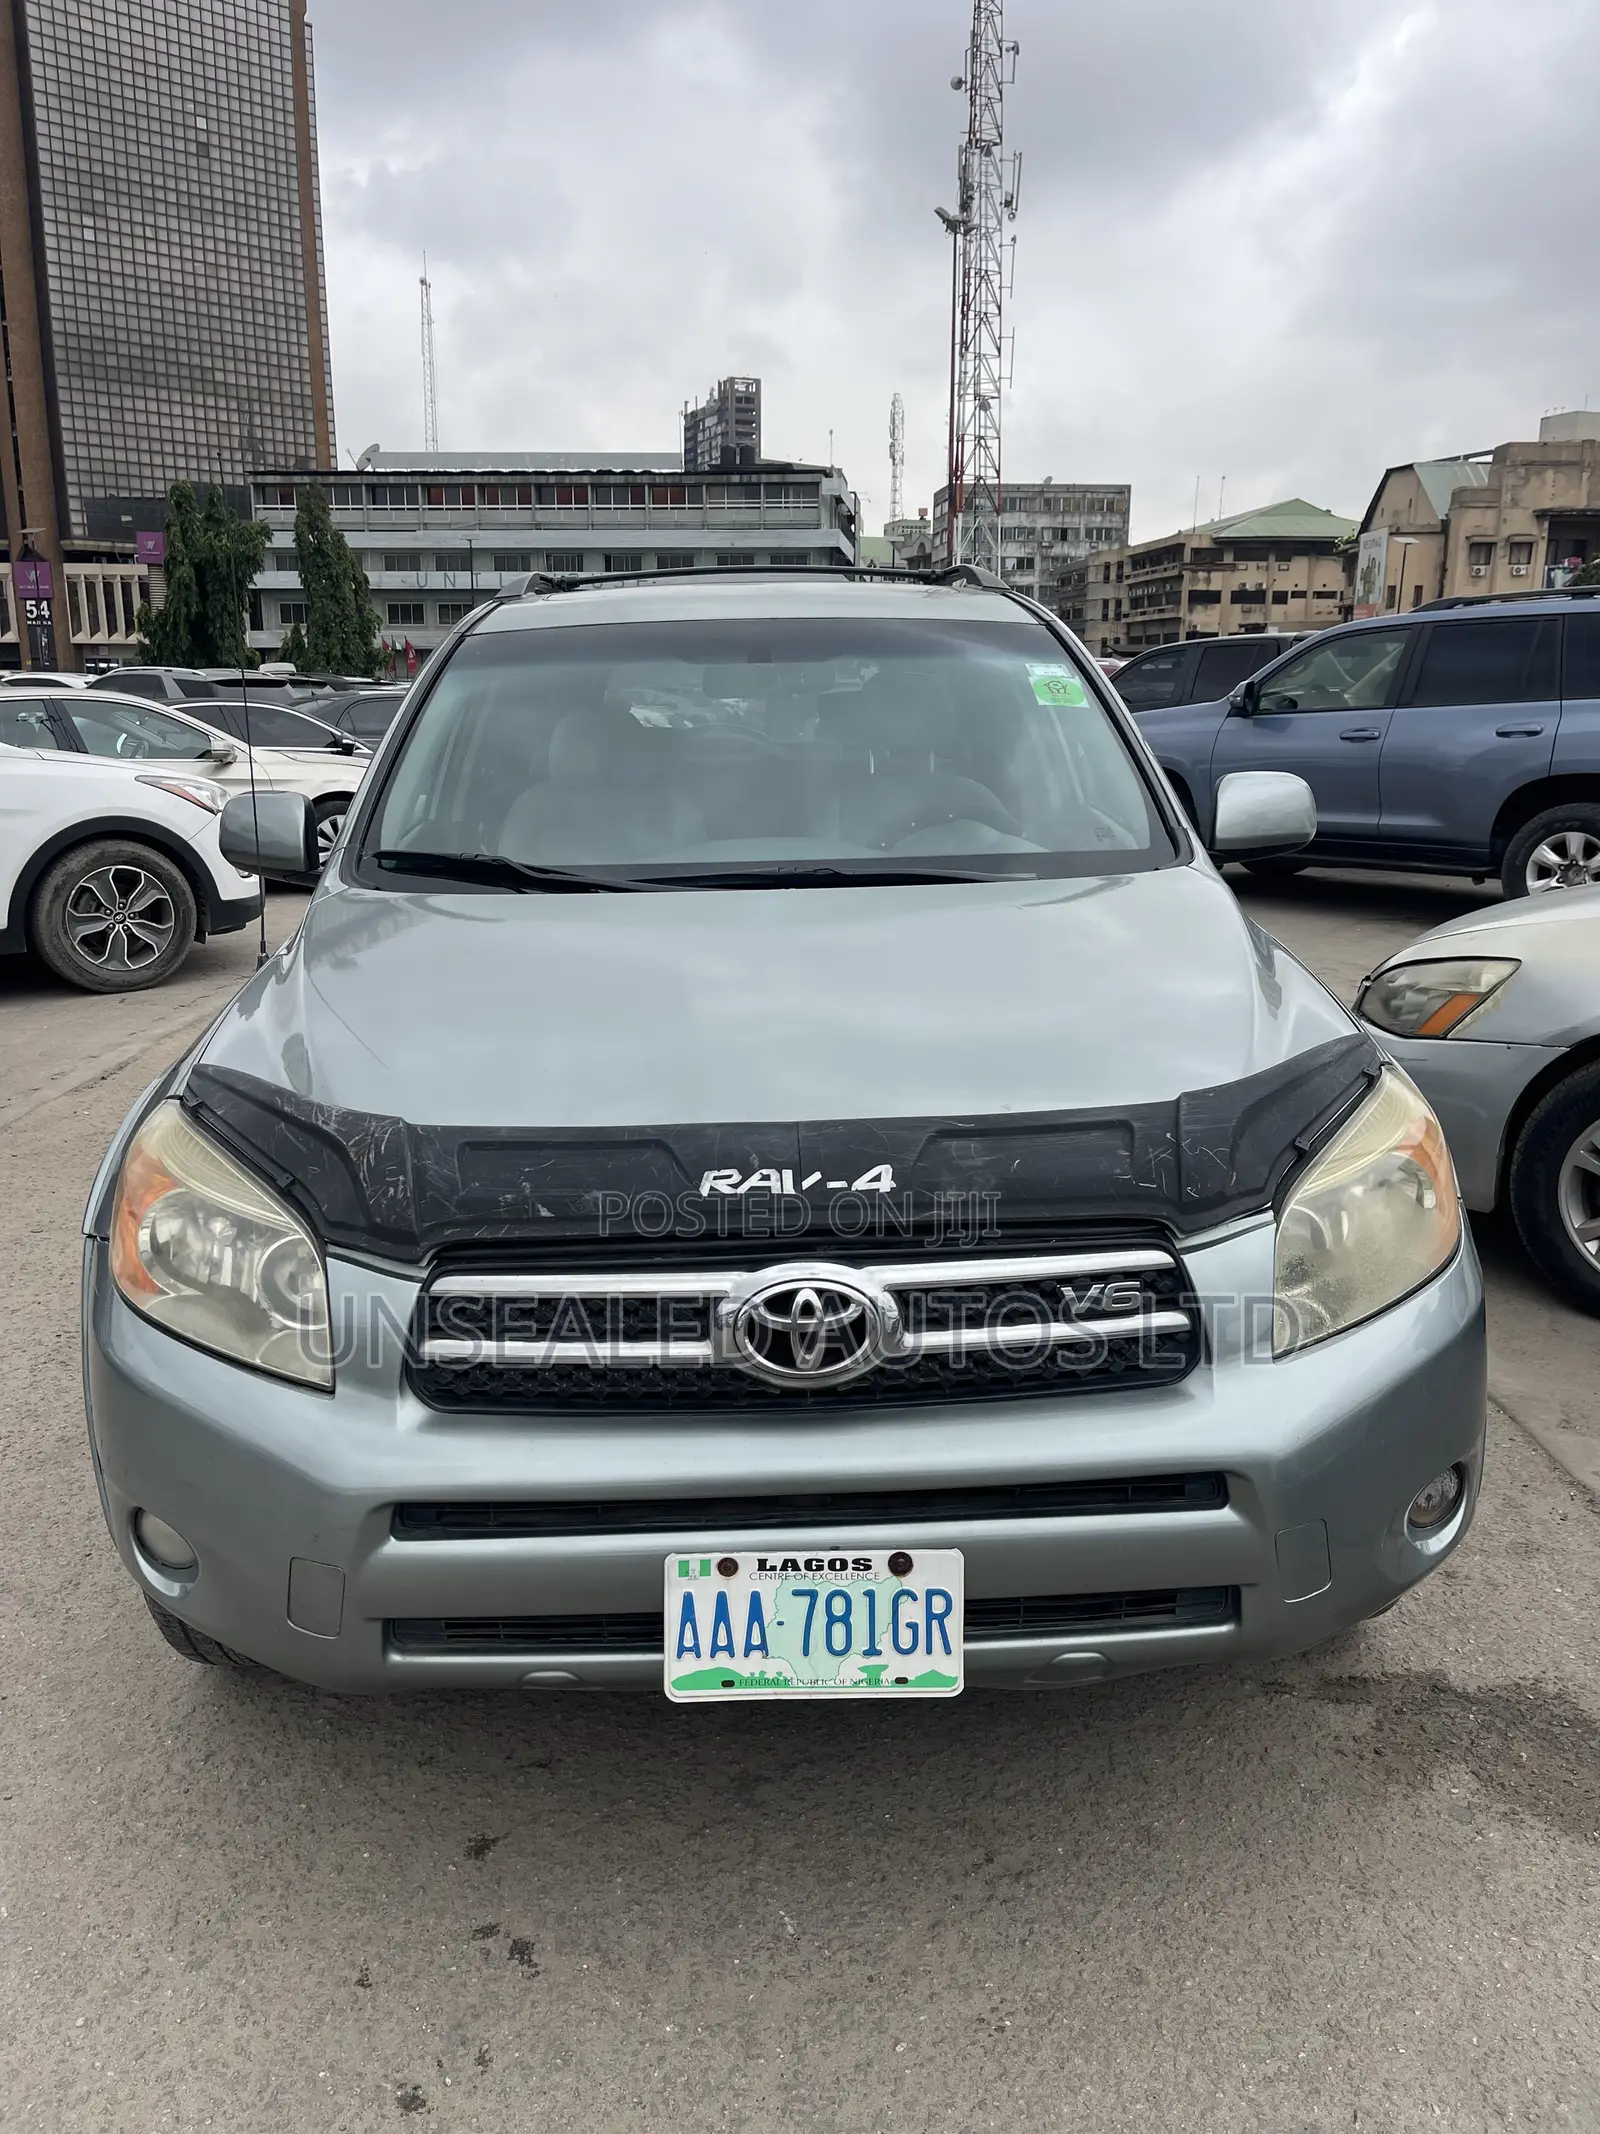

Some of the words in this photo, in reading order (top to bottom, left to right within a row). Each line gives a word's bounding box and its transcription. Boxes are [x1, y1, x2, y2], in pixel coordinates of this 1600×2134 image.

[26, 600, 50, 618] 54
[1061, 1282, 1141, 1314] V6
[757, 1557, 873, 1572] LAGOS
[749, 1572, 793, 1581] CENTRE
[794, 1572, 810, 1580] OF
[812, 1572, 880, 1580] EXCELLENCE
[676, 1588, 953, 1660] AAA-781GR
[739, 1678, 782, 1687] FEDERAL
[834, 1677, 849, 1685] OF
[850, 1677, 890, 1685] NIGERIA
